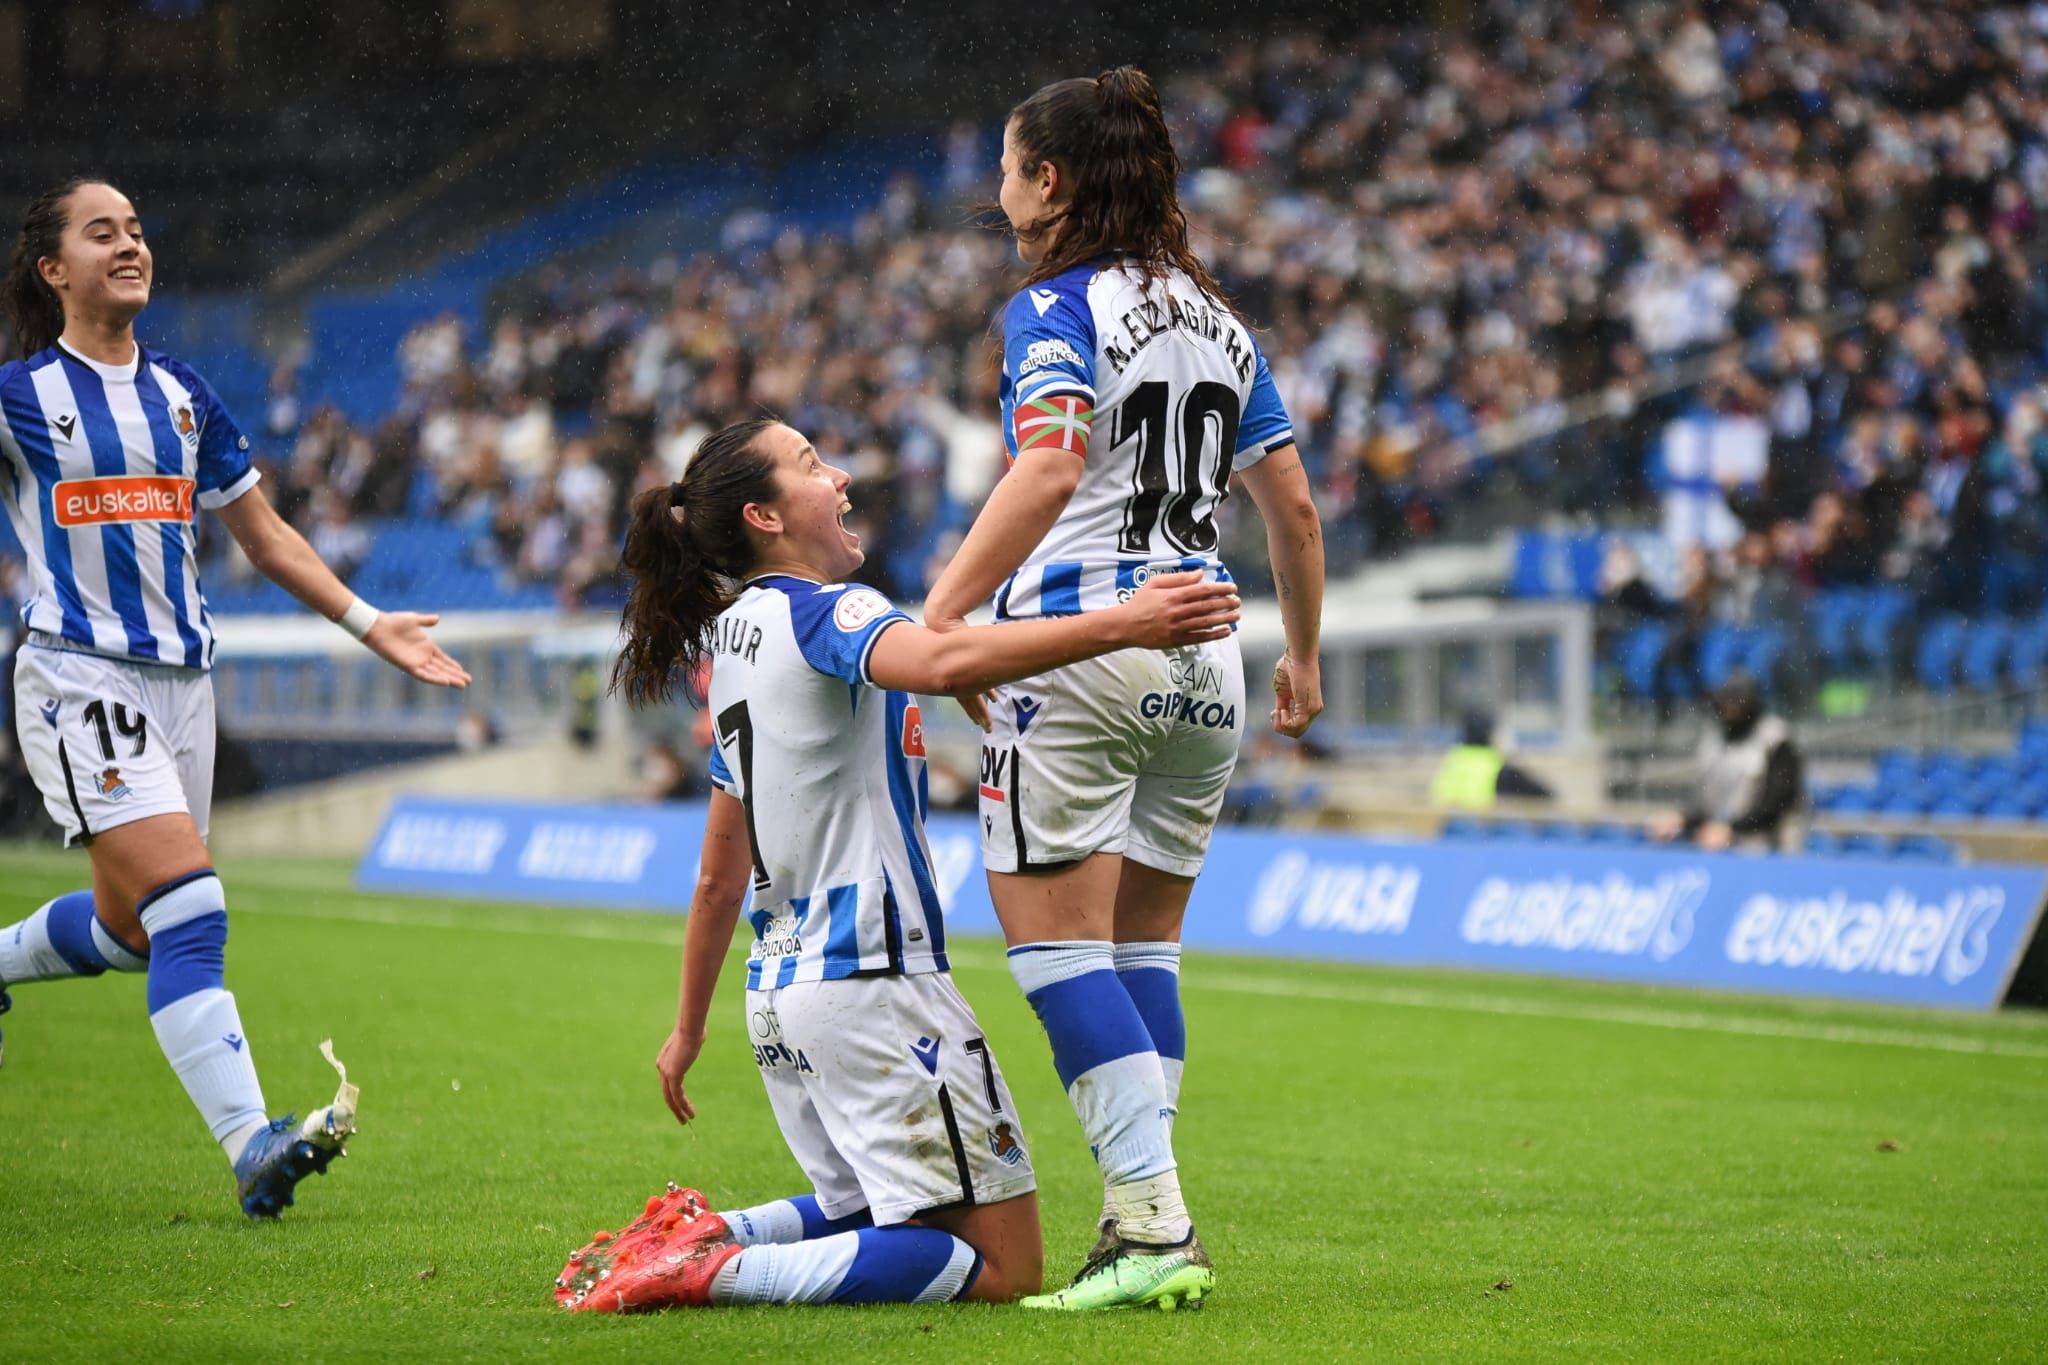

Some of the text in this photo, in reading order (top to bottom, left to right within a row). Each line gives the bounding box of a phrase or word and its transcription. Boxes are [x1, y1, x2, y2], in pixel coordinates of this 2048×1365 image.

[1021, 351, 1085, 373] GIPUZKOA
[1110, 381, 1240, 557] 10
[66, 485, 183, 517] euskaltel
[81, 699, 147, 761] 19
[1140, 692, 1235, 730] GIPKOA
[714, 700, 762, 892] 7
[758, 937, 802, 957] PUZKOA
[1725, 887, 1968, 977] euskaltel
[962, 1037, 1003, 1114] 7
